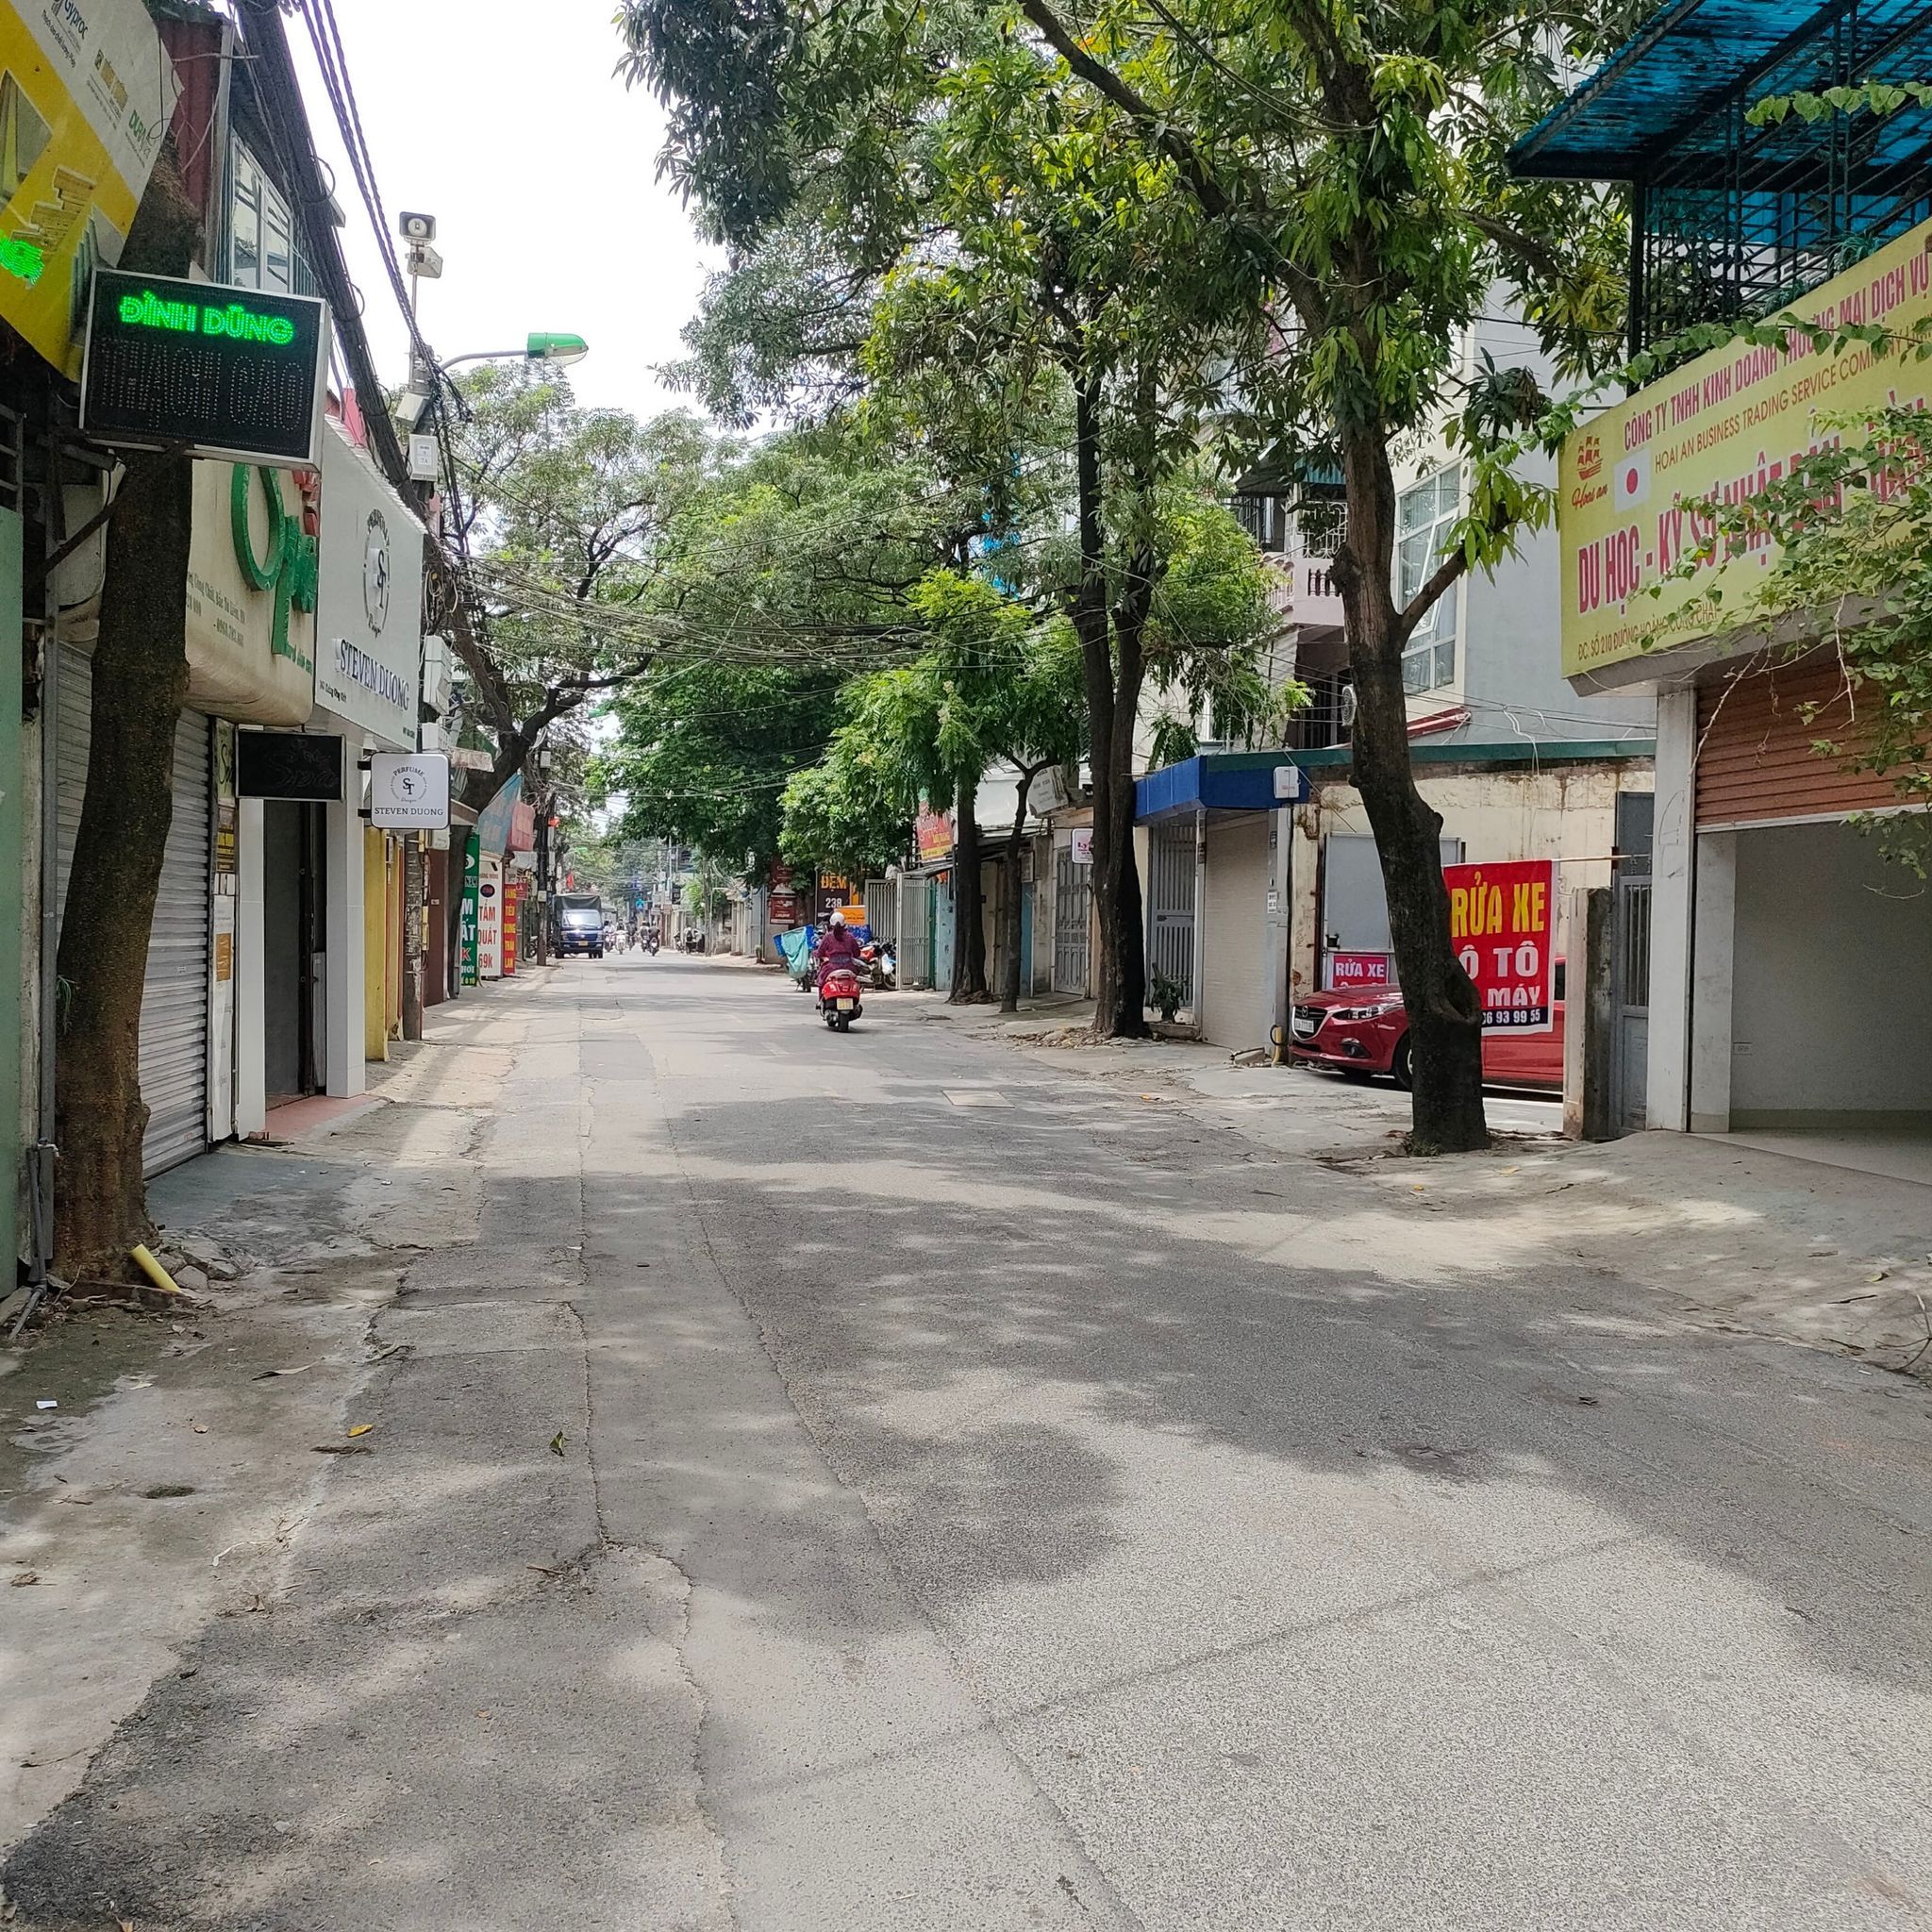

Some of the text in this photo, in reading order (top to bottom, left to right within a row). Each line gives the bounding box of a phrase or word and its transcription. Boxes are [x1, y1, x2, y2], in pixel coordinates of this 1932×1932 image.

[120, 290, 295, 345] ĐÌNH DŨNG
[1624, 411, 1652, 451] CÔNG
[1655, 400, 1667, 435] TY
[1670, 382, 1699, 426] TNHH
[1703, 365, 1731, 409] KINH
[1735, 344, 1777, 392] DOANH
[1872, 264, 1905, 323] DỊCH
[1909, 252, 1929, 299] VỤ
[1655, 444, 1678, 474] HOAI
[1681, 438, 1694, 461] AN
[1697, 413, 1740, 453] BUSINESS
[1742, 389, 1789, 431] TRADING
[1791, 363, 1836, 404] SERVICE
[1578, 541, 1600, 614] DU
[1605, 525, 1640, 615] HỌC
[1601, 635, 1612, 654] 210
[340, 639, 377, 691] STEVEN
[378, 663, 409, 711] DUONG
[393, 766, 425, 776] PERFUME
[375, 807, 443, 816] STEVEN DUONG
[821, 872, 847, 892] ĐỆM
[825, 897, 842, 908] 238
[1451, 871, 1545, 938] RỬA XE
[1335, 958, 1385, 977] RỬA XE
[1493, 941, 1539, 977] TÔ
[1488, 984, 1540, 1007] MÁY
[1496, 1010, 1509, 1024] 93
[1513, 1010, 1527, 1024] 99
[1530, 1008, 1541, 1023] 55
